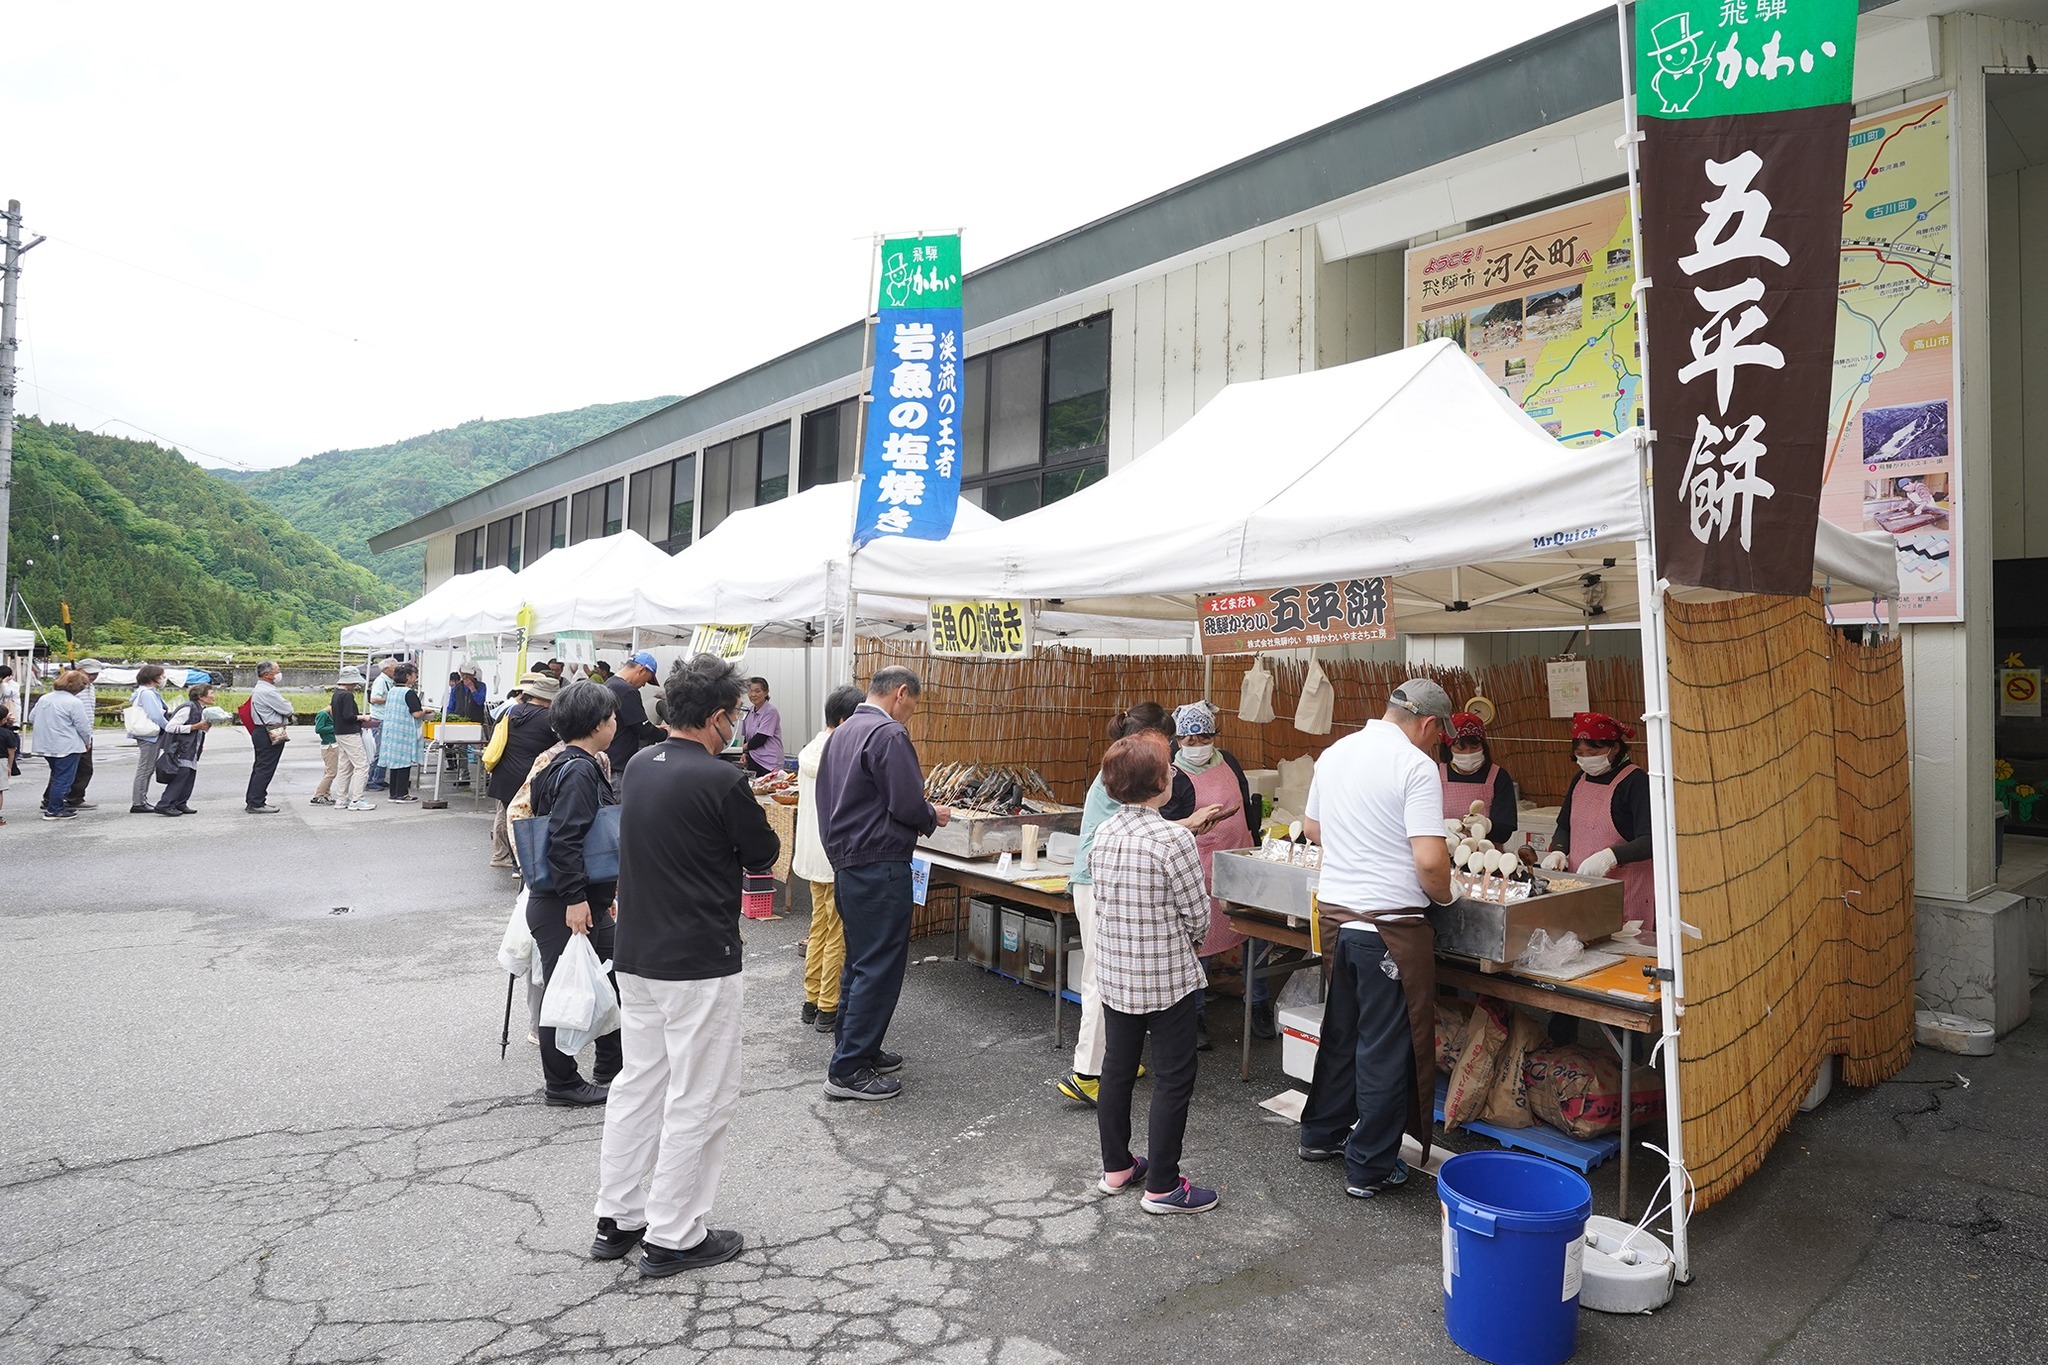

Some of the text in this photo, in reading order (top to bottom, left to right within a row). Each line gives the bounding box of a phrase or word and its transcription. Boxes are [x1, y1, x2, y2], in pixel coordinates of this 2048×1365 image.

[1714, 30, 1837, 89] かわい
[1855, 180, 1865, 189] 41
[1872, 200, 1910, 218] 古川町
[912, 245, 938, 262] 飛騨
[912, 264, 957, 296] かわい
[1676, 148, 1792, 554] 五平餅
[1913, 335, 1949, 351] 高山市
[874, 322, 936, 534] 岩魚の塩焼き
[1203, 576, 1387, 637] 飛騨かわい 五平餅
[1210, 596, 1257, 612] えごまだれ
[1305, 630, 1387, 647] 飛騨かわいやまさち工房
